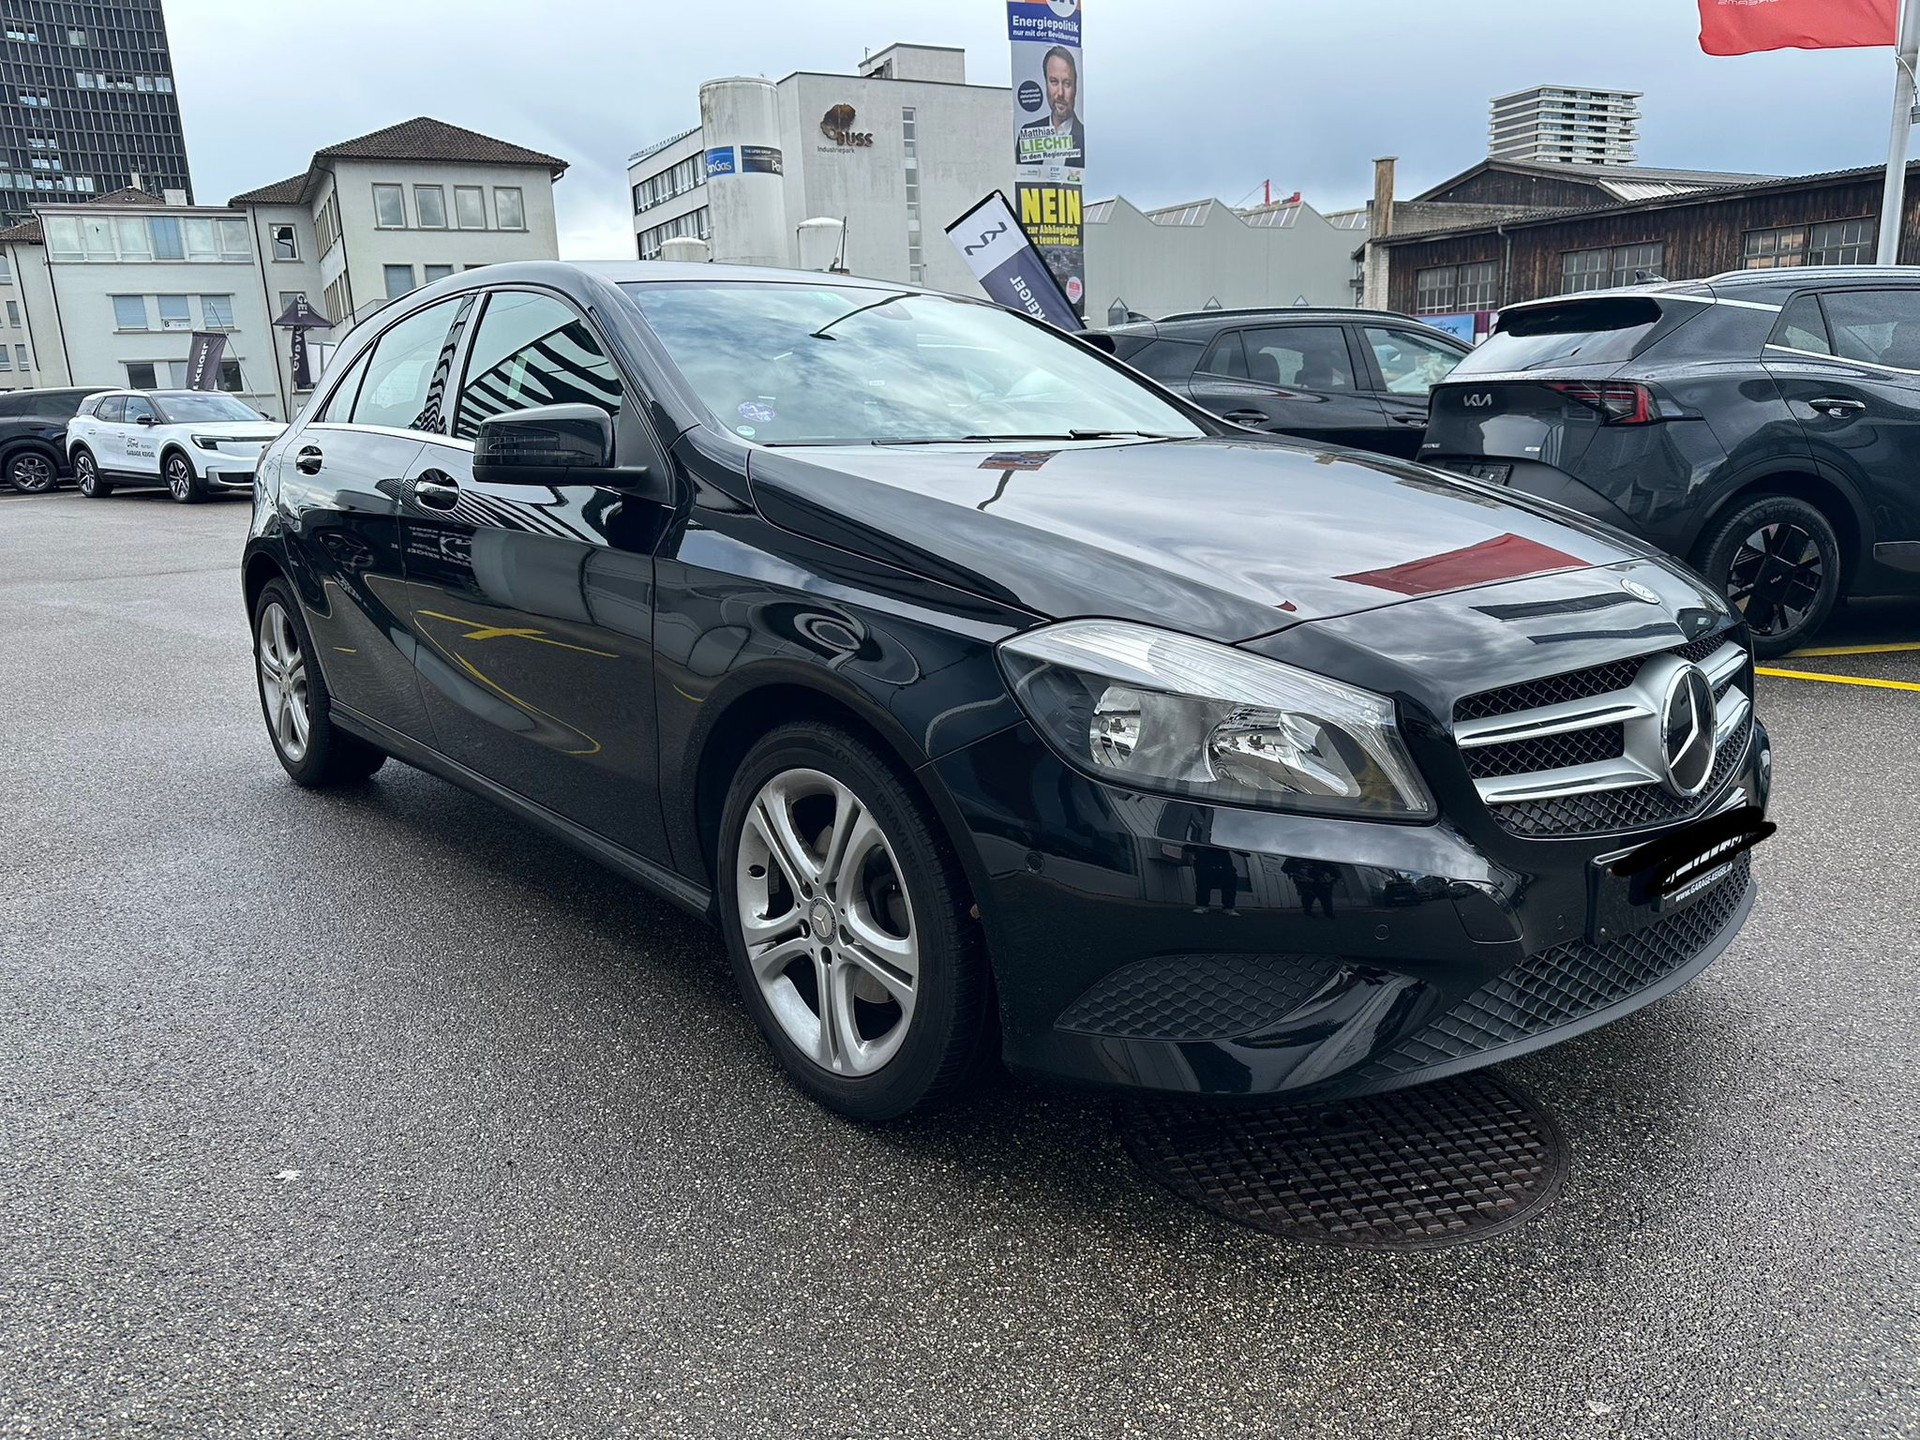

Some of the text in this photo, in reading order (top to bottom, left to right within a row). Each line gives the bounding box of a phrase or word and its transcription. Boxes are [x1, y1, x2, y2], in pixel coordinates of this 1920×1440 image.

[1012, 15, 1079, 33] Energiepolitik
[1020, 127, 1055, 138] Matthias
[817, 146, 855, 154] Industriepark
[1021, 136, 1072, 152] LIECHTI
[707, 160, 732, 173] anGas
[1020, 188, 1081, 225] NEIN
[1027, 224, 1078, 237] zur Abhängigkeit
[1039, 235, 1060, 245] teurer
[1060, 236, 1079, 246] Energie
